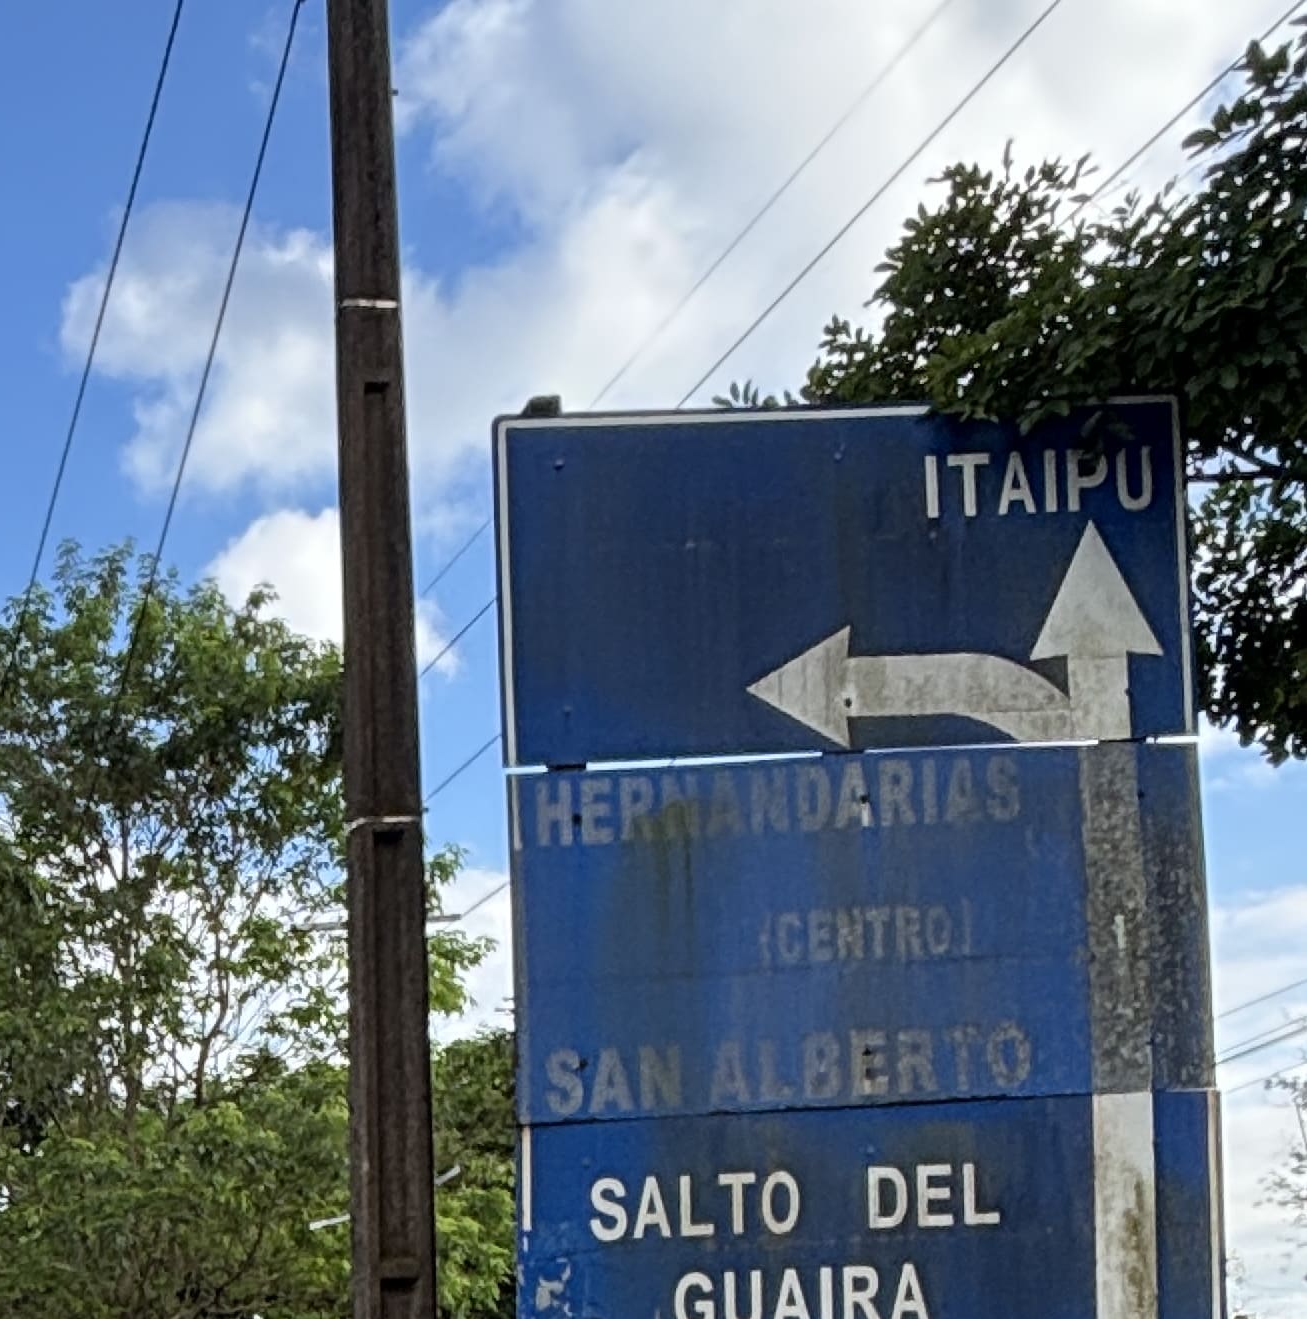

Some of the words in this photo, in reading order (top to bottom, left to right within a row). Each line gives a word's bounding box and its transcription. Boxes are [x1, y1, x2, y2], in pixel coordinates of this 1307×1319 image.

[924, 446, 1153, 518] ITAIPU
[536, 755, 1022, 847] HERNANDARIAS
[545, 1044, 682, 1116] SAN
[710, 1019, 1031, 1101] ALBERTO
[590, 1170, 800, 1241] SALTO
[867, 1163, 1001, 1229] DEL
